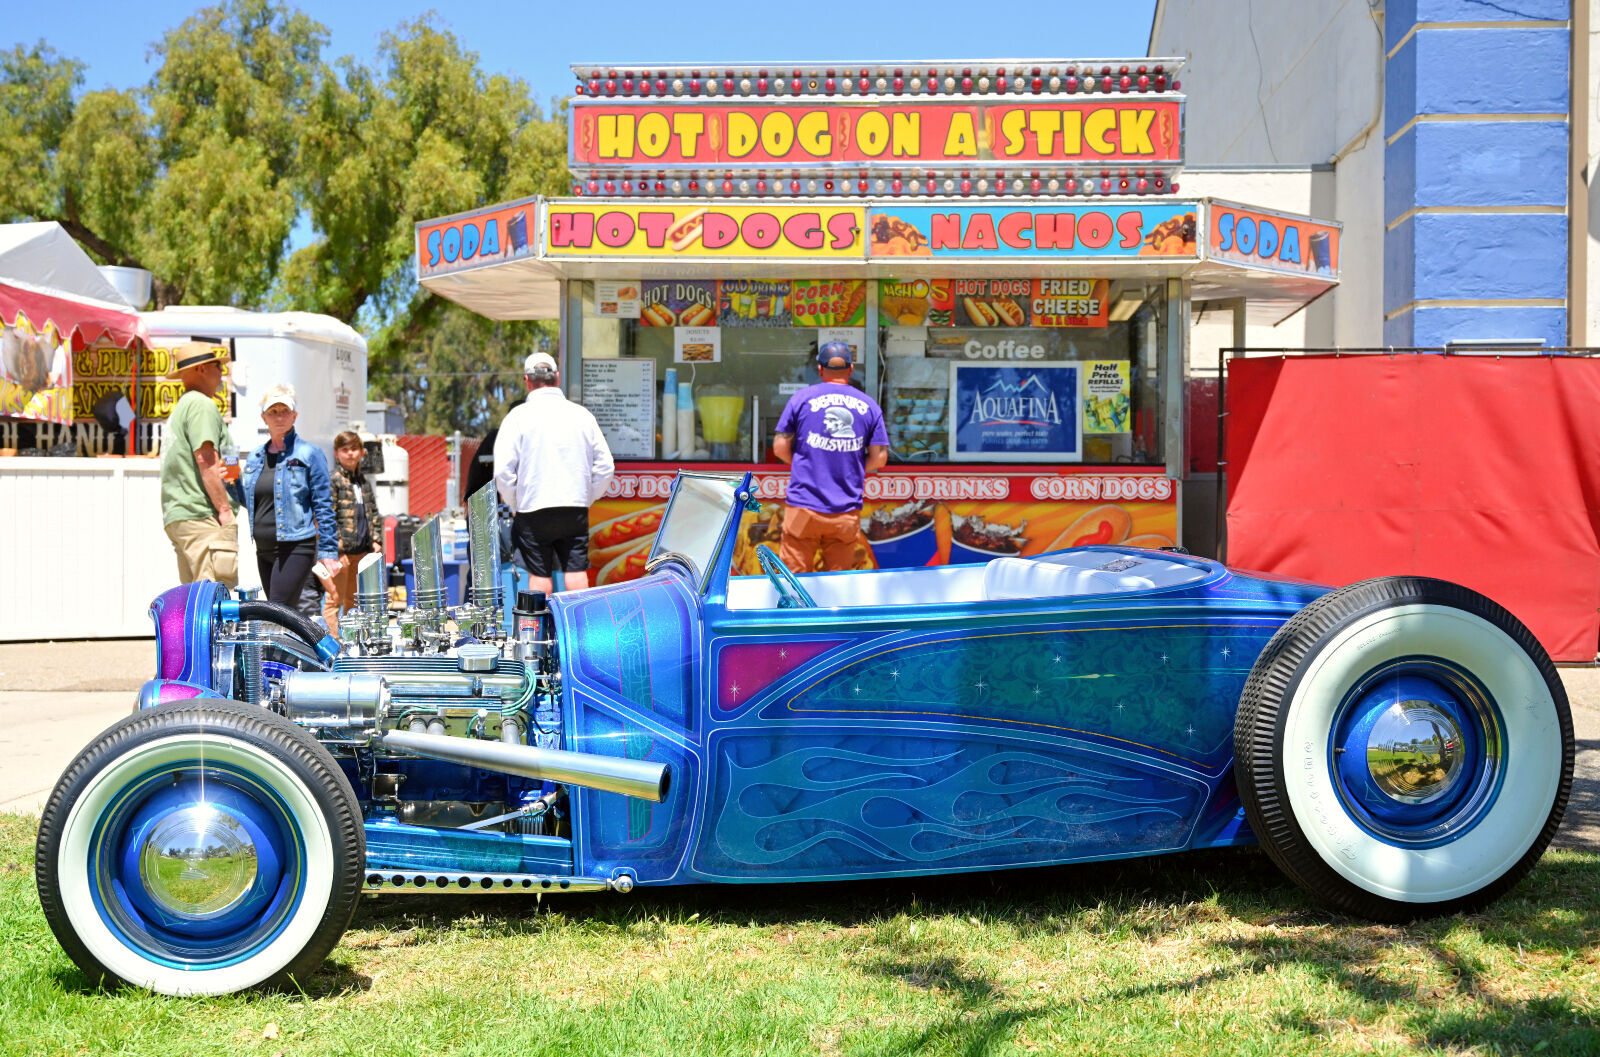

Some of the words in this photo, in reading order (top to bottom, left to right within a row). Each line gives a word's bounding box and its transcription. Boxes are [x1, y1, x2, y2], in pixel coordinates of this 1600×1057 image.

[597, 112, 704, 158] HOT
[727, 111, 832, 157] DOG
[856, 111, 920, 156] ON
[943, 111, 978, 156] A
[1001, 108, 1156, 155] STICK
[551, 212, 675, 247] HOT
[702, 212, 857, 248] DOGS
[931, 212, 1143, 248] NACHOS
[1219, 213, 1301, 263] SODA
[427, 219, 500, 267] SODA
[644, 284, 669, 309] HOT
[676, 283, 712, 309] DOGS
[720, 280, 748, 294] COLD
[749, 281, 791, 296] DRINKS
[795, 281, 844, 300] CORN
[883, 279, 950, 302] NACHOS
[956, 280, 986, 296] HOT
[990, 280, 1031, 296] DOGS
[1040, 279, 1090, 296] FRIED
[795, 300, 841, 317] DOGS
[1032, 298, 1099, 316] CHEESE
[964, 340, 1045, 359] Coffee
[1092, 371, 1119, 379] Price
[1094, 363, 1118, 371] Half
[969, 391, 1061, 424] AQUAFINA
[806, 431, 864, 452] KOOLSVILLE
[604, 475, 638, 497] OT
[638, 475, 676, 497] DO
[864, 477, 915, 499] OLD
[915, 477, 1009, 499] DRINKS
[1031, 477, 1101, 499] CORN
[1101, 477, 1171, 499] DOGS
